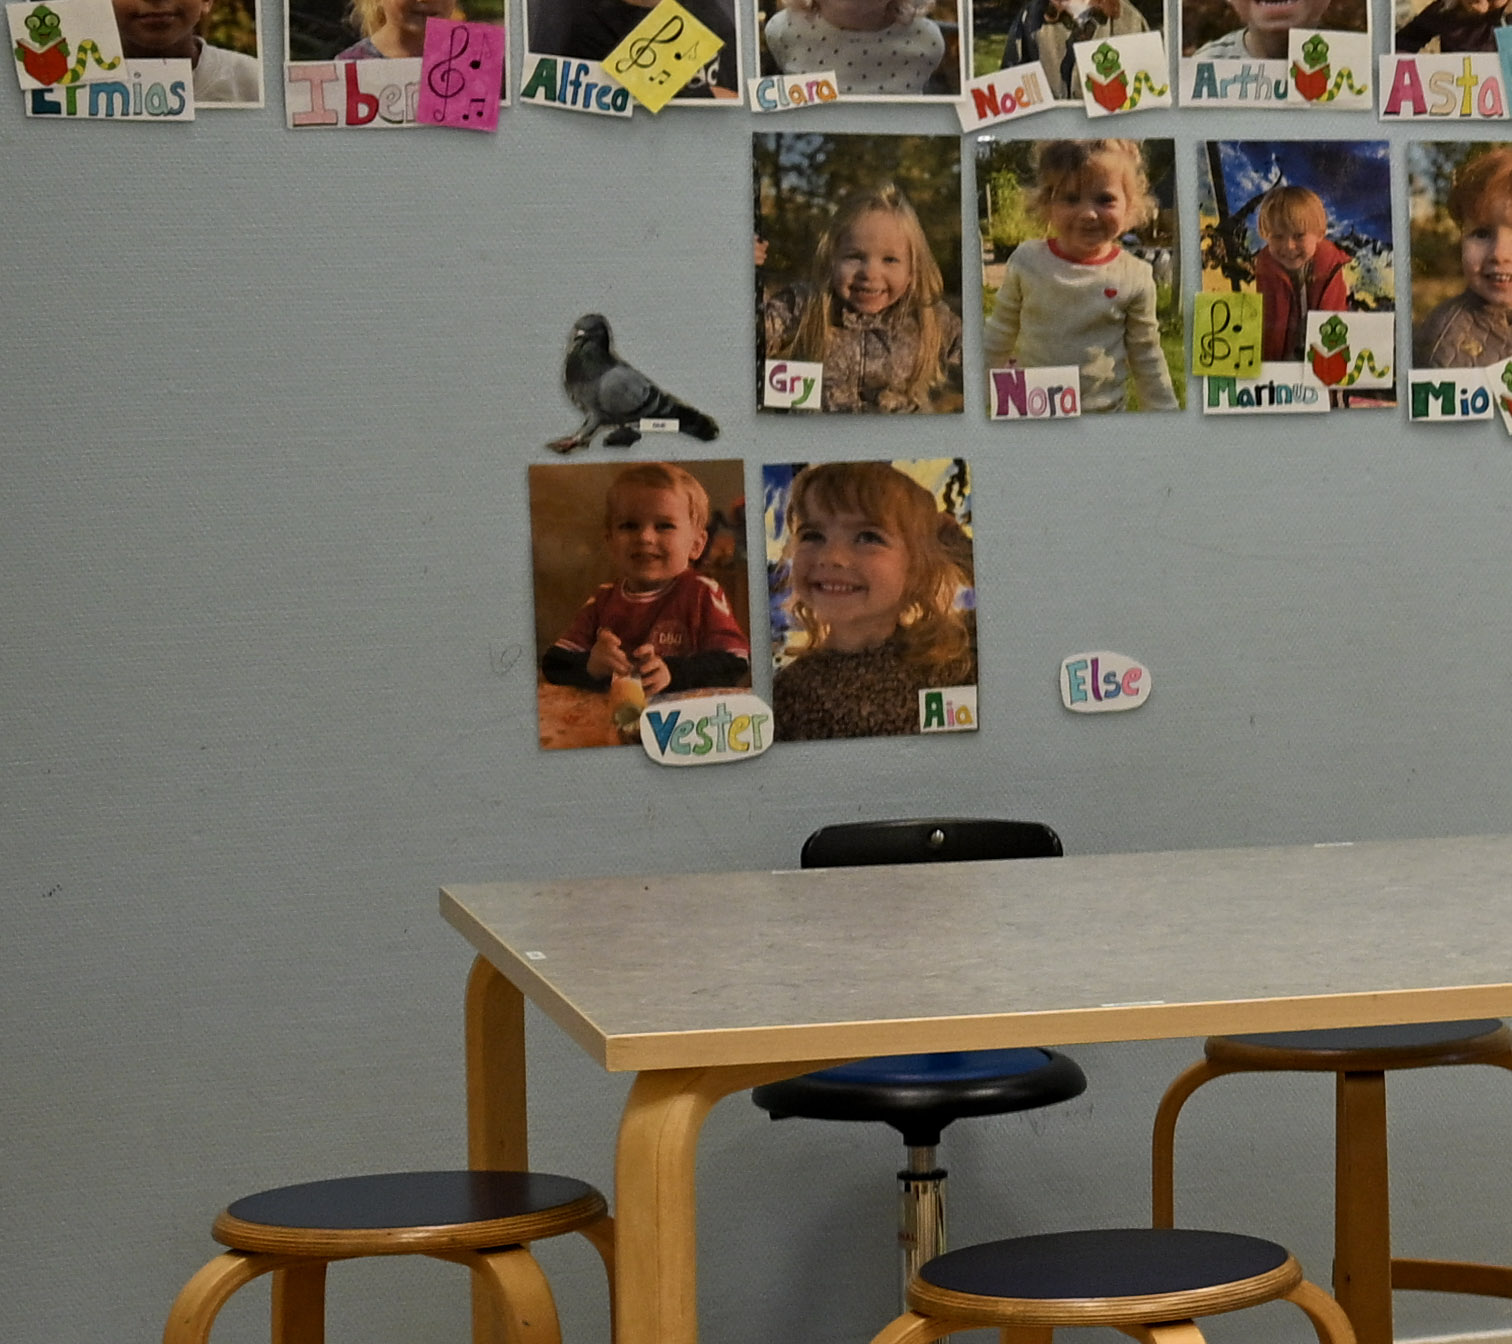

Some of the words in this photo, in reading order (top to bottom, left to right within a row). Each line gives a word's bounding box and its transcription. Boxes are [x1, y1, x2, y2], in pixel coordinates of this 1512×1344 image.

[31, 71, 186, 117] Ermias
[756, 78, 838, 109] Clara
[1191, 61, 1288, 101] Arthu
[1383, 56, 1504, 118] Asta
[768, 361, 816, 407] Gry
[992, 369, 1078, 417] Nora
[1411, 381, 1490, 418] Mio
[1066, 657, 1143, 706] Else
[646, 702, 769, 757] Vester
[923, 691, 974, 729] Aia
